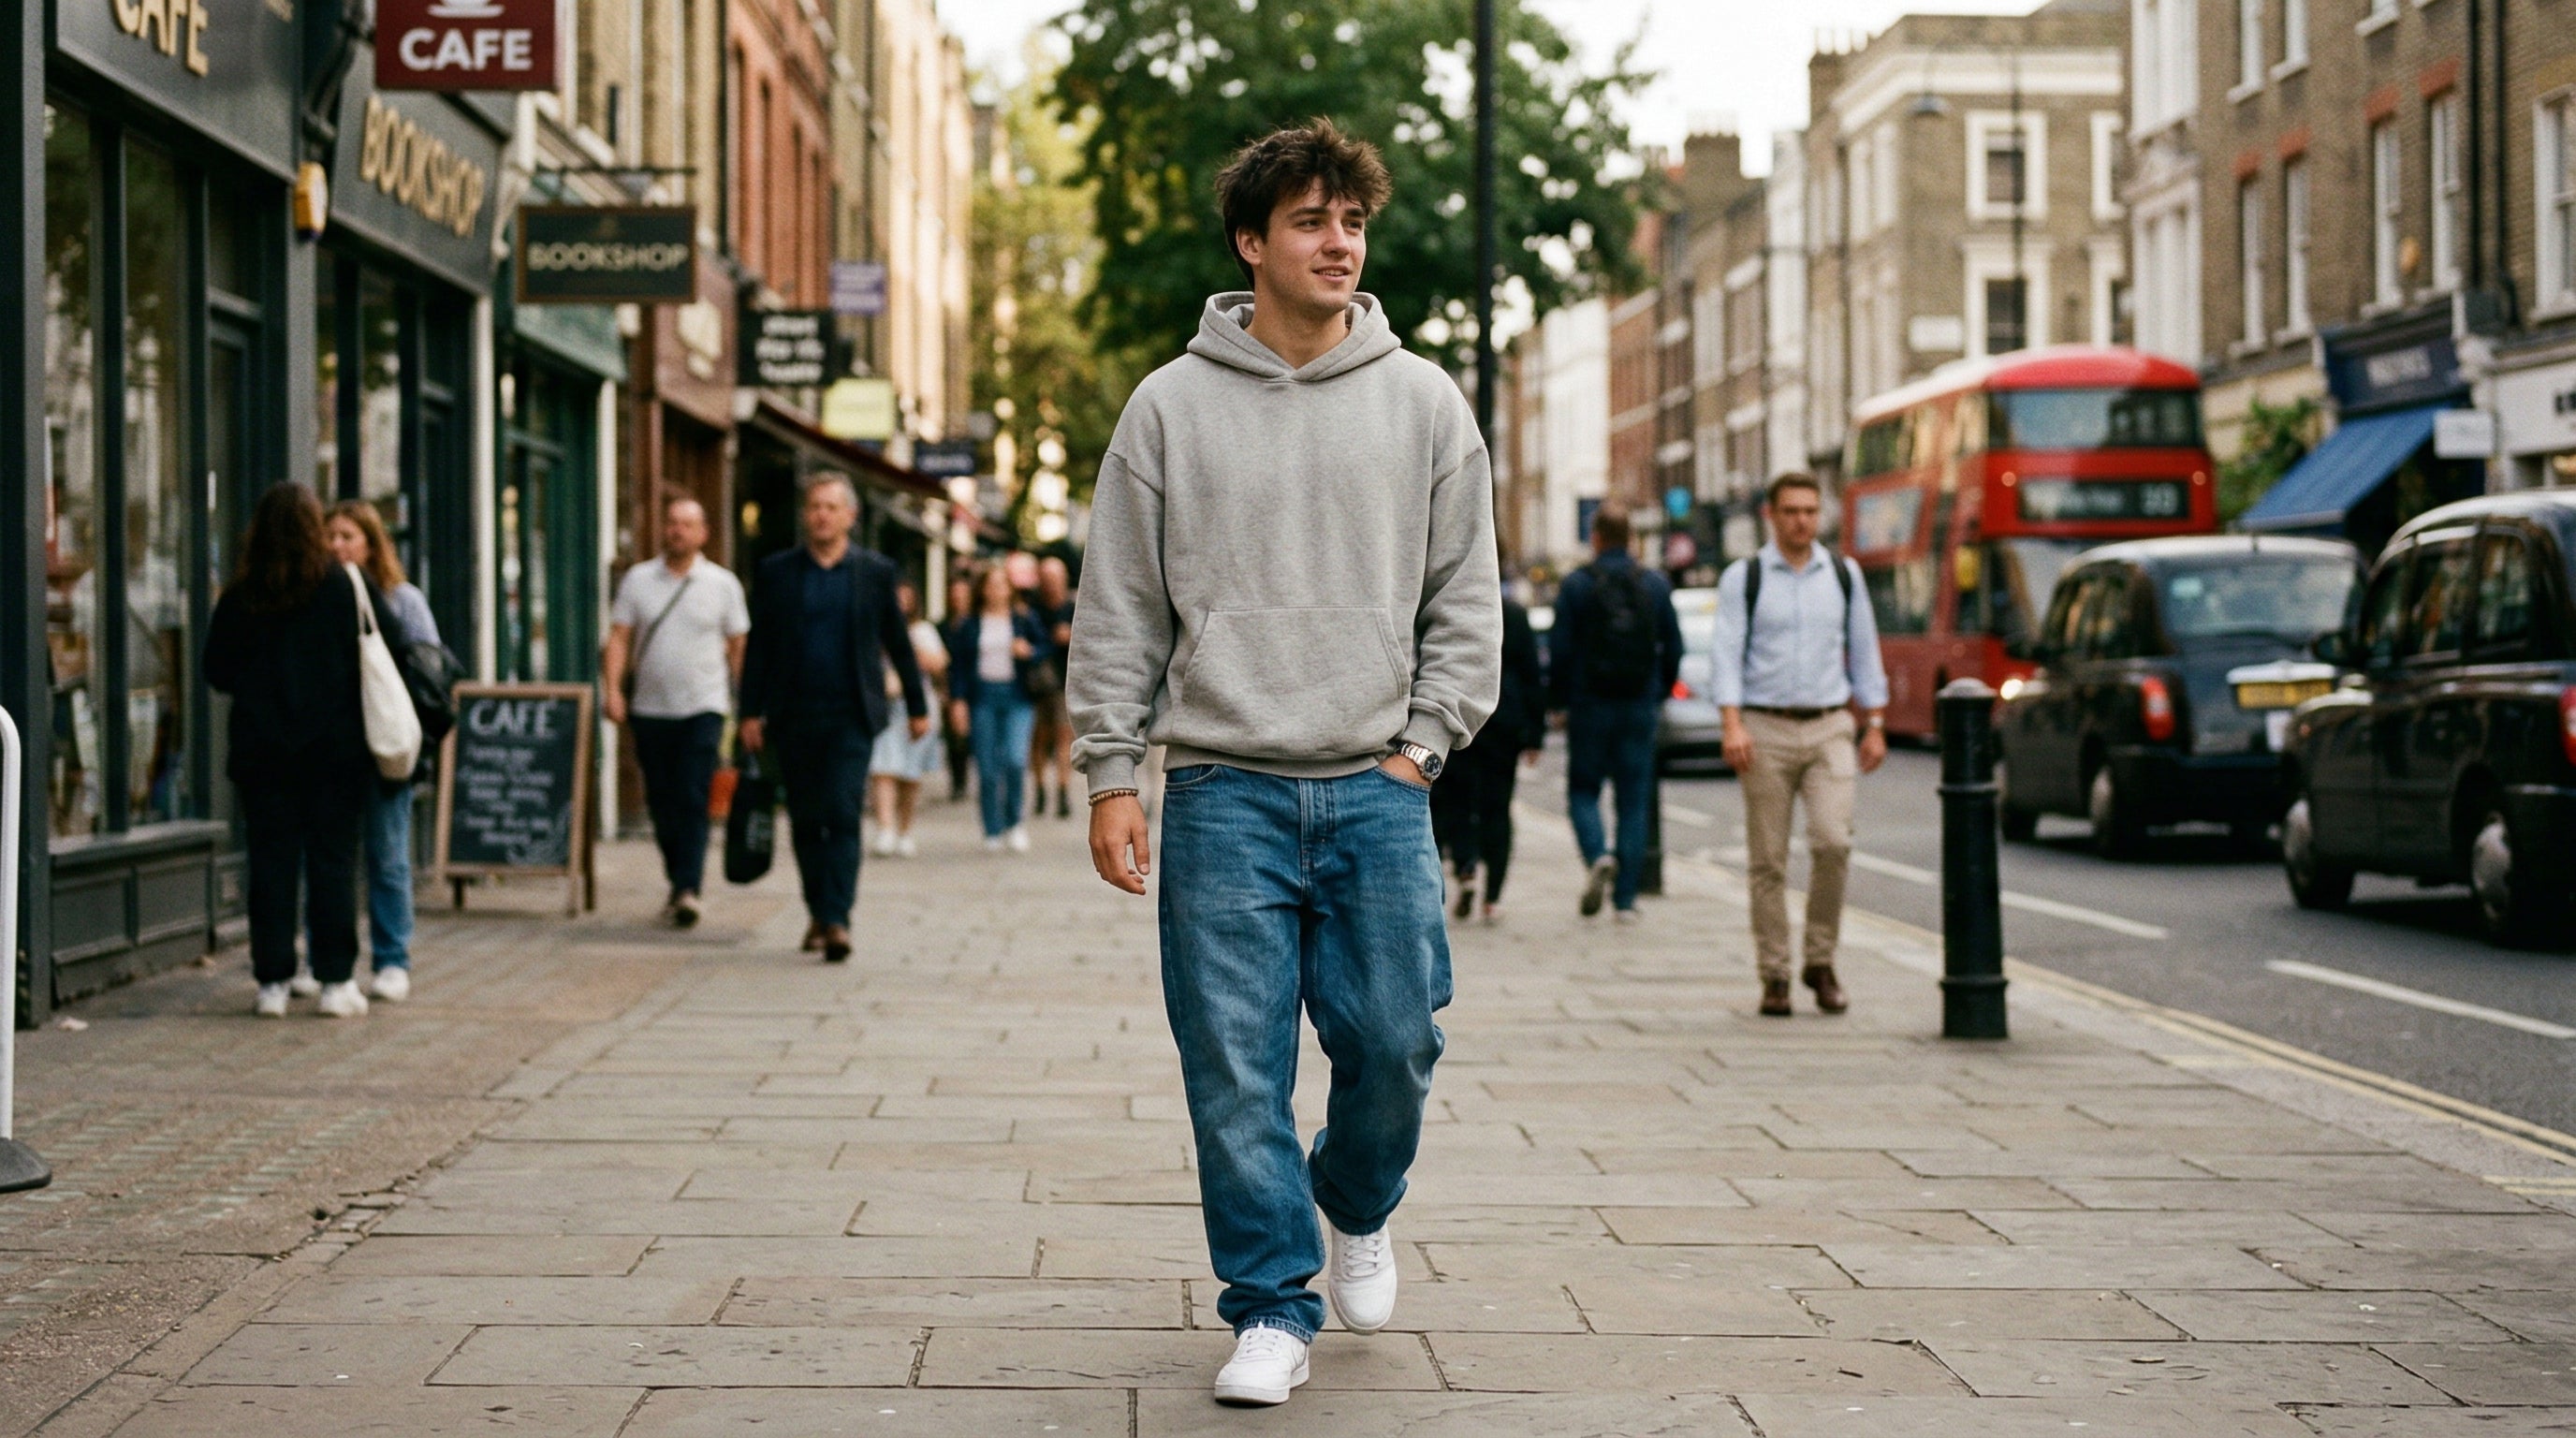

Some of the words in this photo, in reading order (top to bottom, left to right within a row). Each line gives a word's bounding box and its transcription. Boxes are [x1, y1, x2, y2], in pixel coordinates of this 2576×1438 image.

[399, 27, 534, 71] CAFE
[360, 95, 485, 239] BOOKSHOP
[527, 242, 689, 271] BOOKSHOP
[470, 699, 560, 739] CAFE
